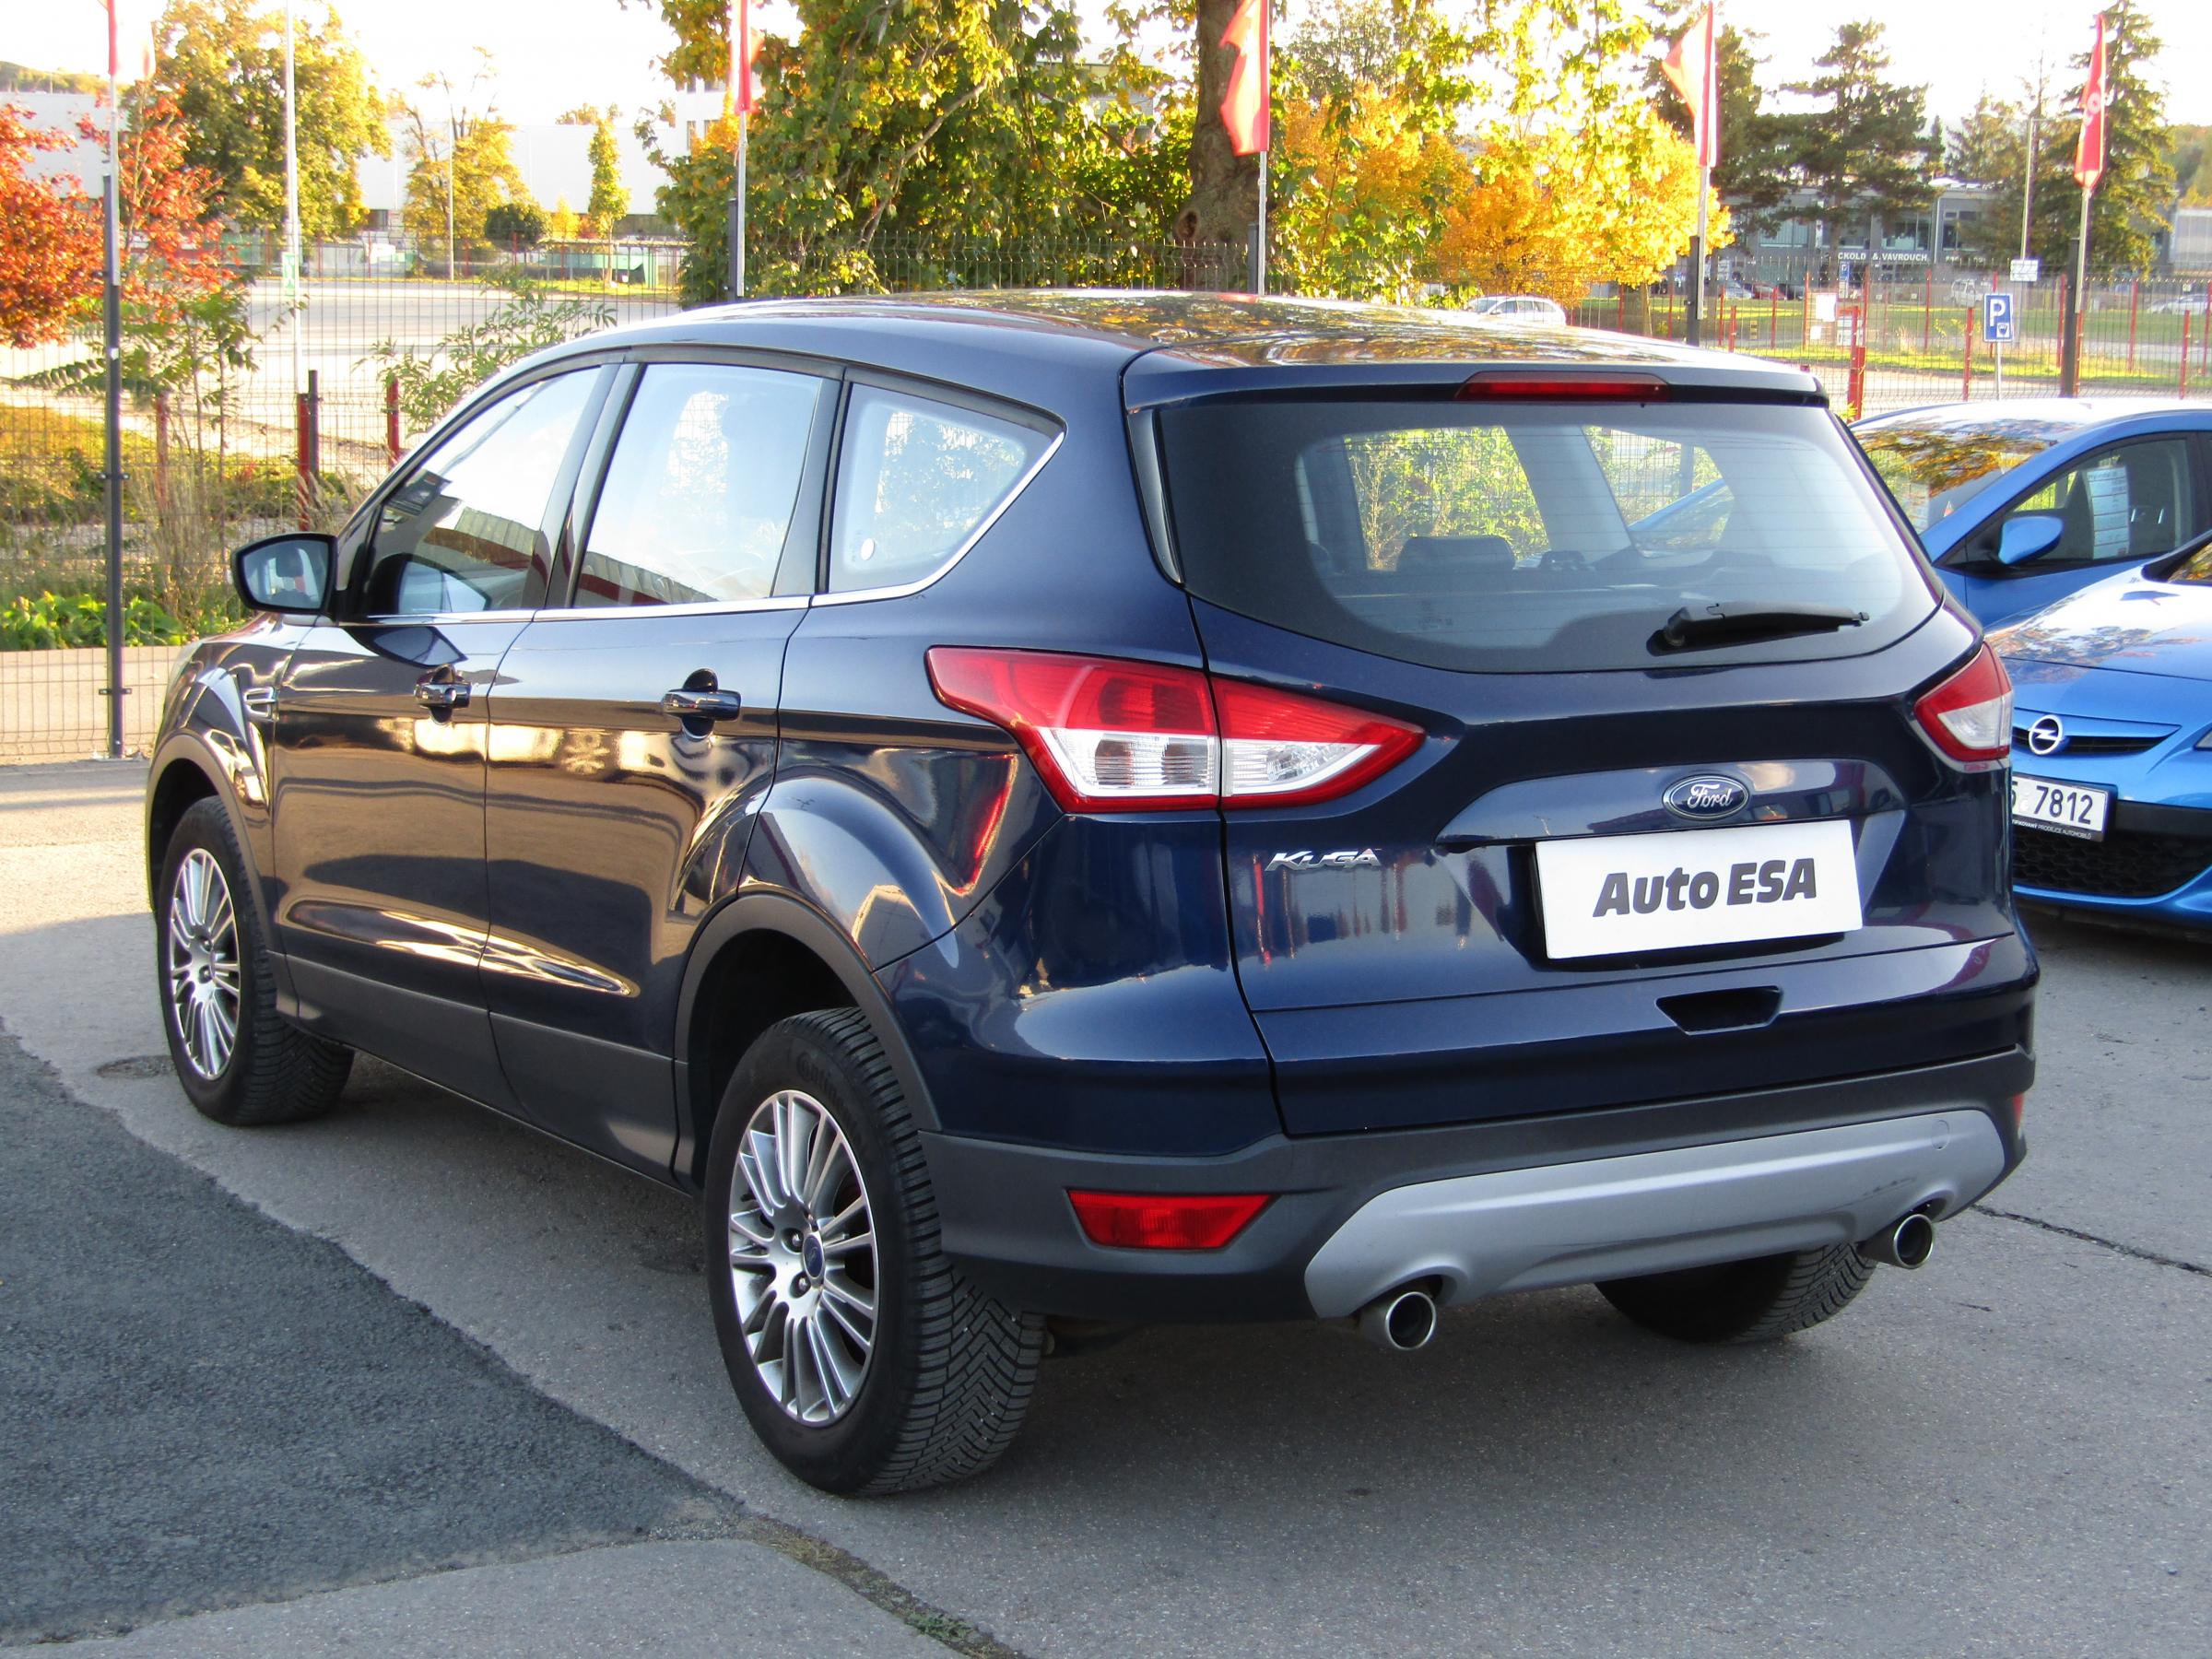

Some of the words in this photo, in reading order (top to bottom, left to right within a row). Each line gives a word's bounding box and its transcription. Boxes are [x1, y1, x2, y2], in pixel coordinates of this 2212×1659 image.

[1838, 252, 1866, 261] CKOLD
[1872, 253, 1878, 261] &
[1881, 252, 1928, 262] VAVROUCH
[1990, 299, 2006, 327] P
[1687, 783, 1734, 808] Ford
[2033, 785, 2093, 825] 7812
[1265, 848, 1382, 872] KUGA
[1592, 867, 1720, 918] Auto
[1726, 857, 1817, 906] ESA
